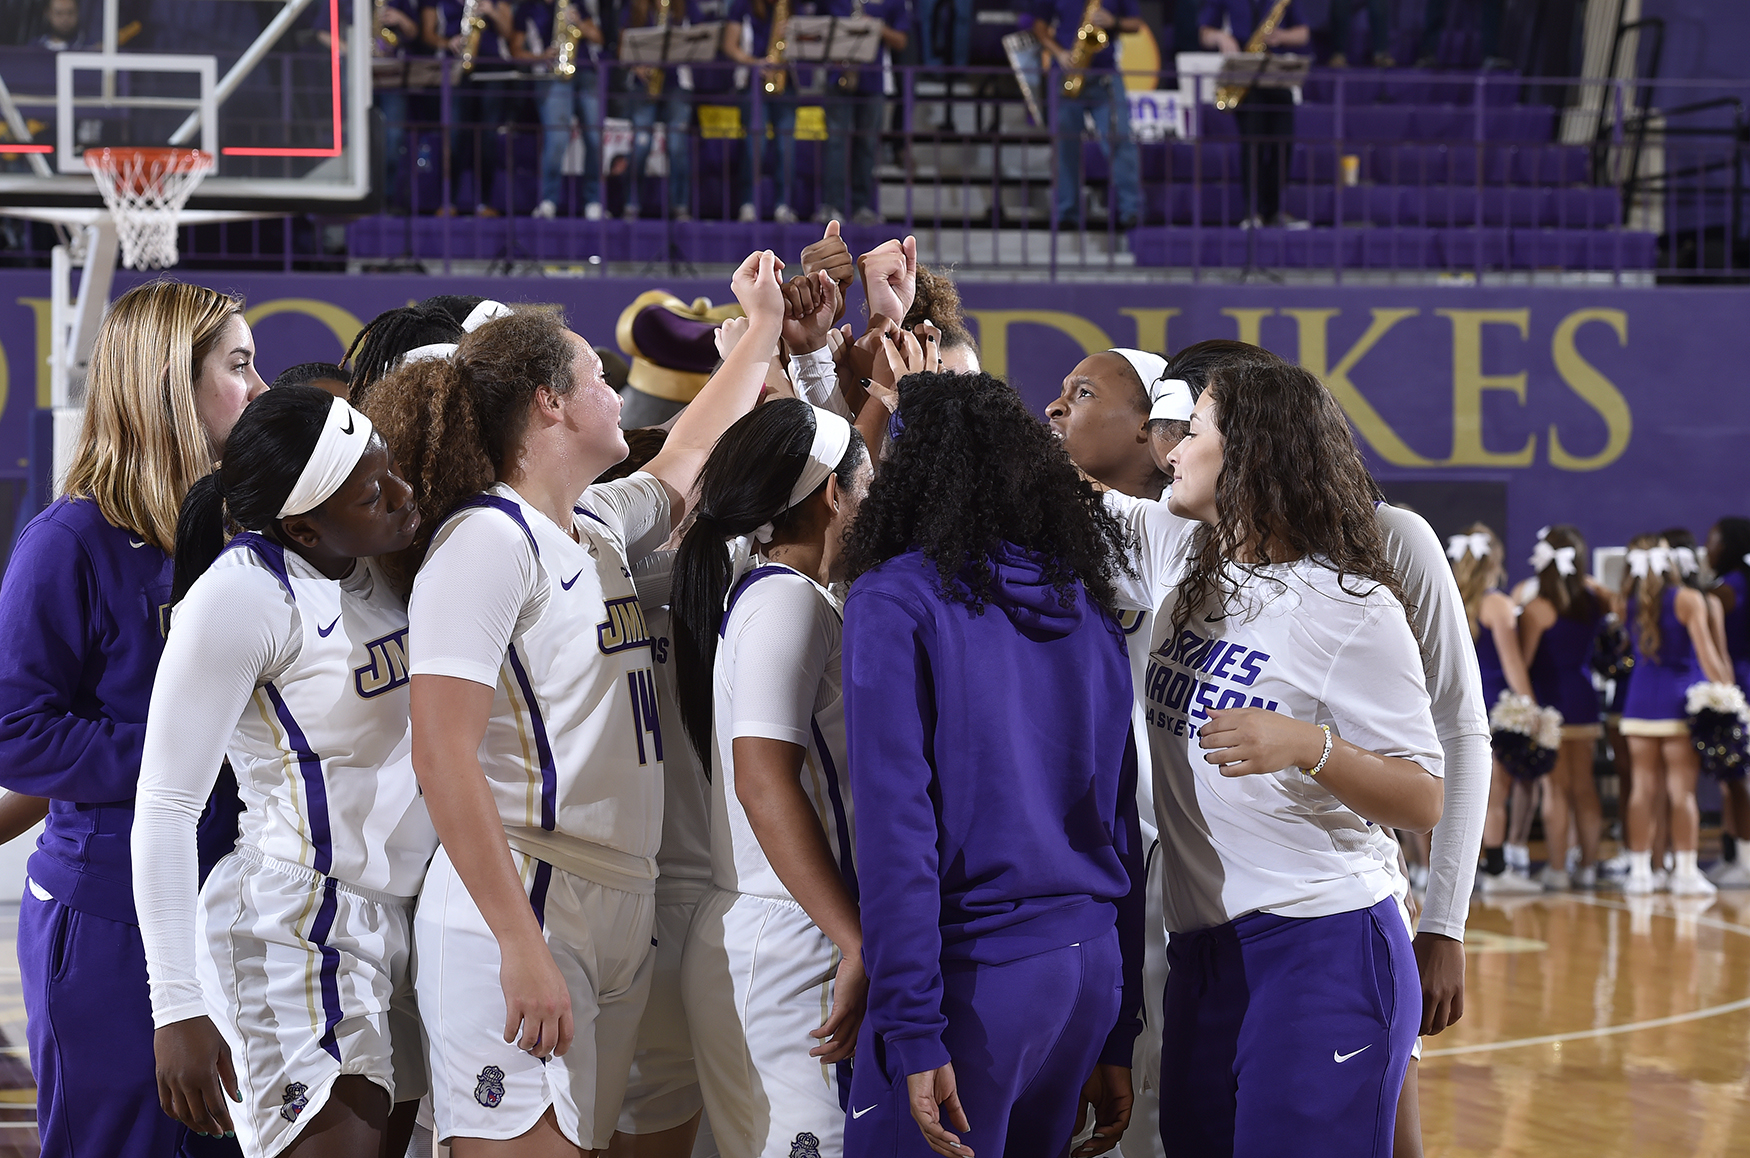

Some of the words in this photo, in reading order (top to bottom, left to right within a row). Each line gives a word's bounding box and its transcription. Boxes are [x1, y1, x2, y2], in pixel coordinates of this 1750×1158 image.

[1159, 629, 1271, 687] JAMES
[626, 667, 664, 768] 14
[1146, 706, 1203, 740] ASKET
